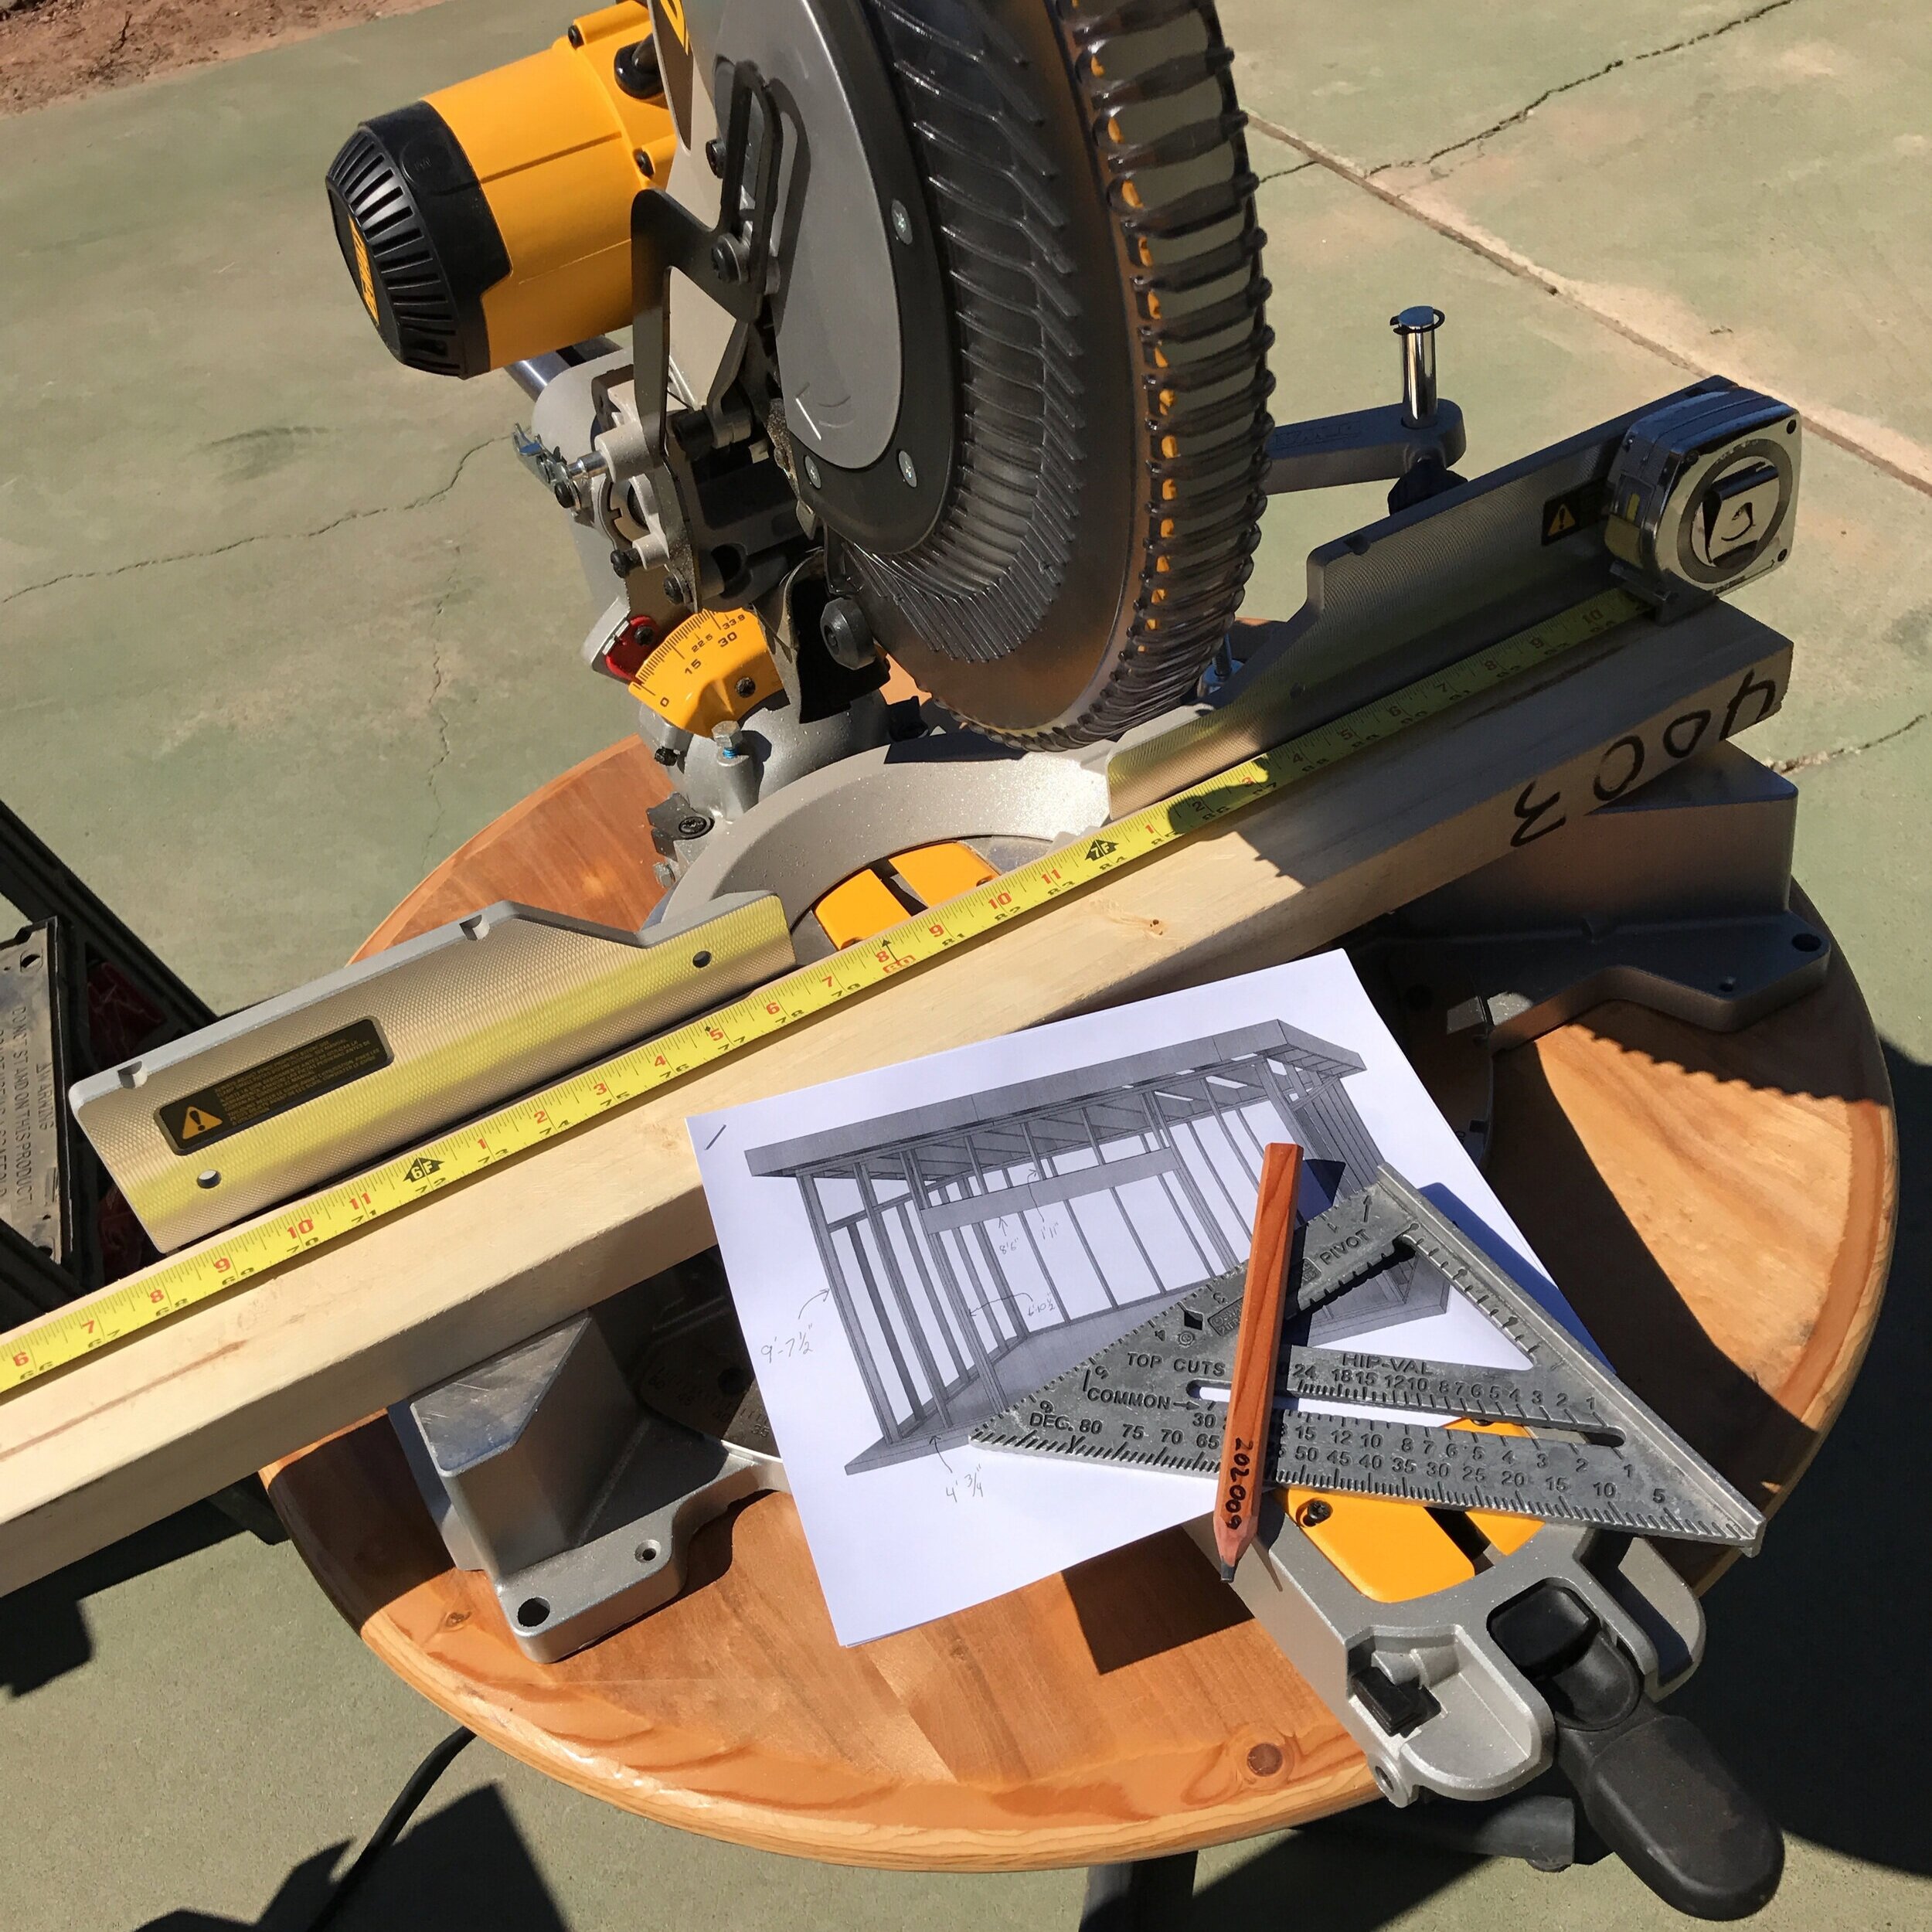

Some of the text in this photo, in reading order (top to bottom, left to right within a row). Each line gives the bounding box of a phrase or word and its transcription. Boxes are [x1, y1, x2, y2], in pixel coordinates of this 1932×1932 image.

[691, 633, 714, 654] 22.5
[717, 631, 738, 648] 30
[685, 659, 702, 675] 15
[659, 696, 670, 708] 0
[13, 1351, 29, 1367] 6
[82, 1319, 96, 1334] 7
[149, 1288, 165, 1304] 8
[215, 1257, 230, 1273] 9
[287, 1218, 315, 1239] 10
[349, 1192, 372, 1210] 11
[411, 1160, 434, 1181] 6F
[477, 1138, 487, 1150] 1
[534, 1110, 547, 1124] 2
[593, 1082, 607, 1097] 3
[654, 1054, 667, 1068] 4
[709, 1027, 724, 1042] 5
[766, 1001, 781, 1015] 6
[821, 975, 834, 988] 7
[875, 950, 889, 964] 8
[928, 923, 944, 938] 9
[988, 891, 1012, 910] 10
[1041, 868, 1063, 885] 11
[1090, 841, 1112, 859] 7F
[1145, 824, 1155, 835] 1
[1192, 800, 1206, 813] 2
[1292, 752, 1304, 764] 4
[1339, 728, 1353, 741] 5
[1389, 704, 1402, 718] 6
[1319, 1228, 1371, 1267] PIVOT
[1127, 1352, 1226, 1377] TOP CUTS
[1342, 1352, 1435, 1375] HIP-VAL
[1292, 1362, 1597, 1410] 24 18 15 12 10 8 7 6 5 4 3 2 1
[1087, 1387, 1172, 1410] COMMON
[1192, 1412, 1217, 1429] 30
[1295, 1424, 1318, 1441] 15
[1331, 1430, 1352, 1445] 12
[1360, 1434, 1383, 1448] 10
[1401, 1437, 1414, 1453] 8
[1423, 1440, 1436, 1454] 7
[1446, 1442, 1458, 1458] 6
[1472, 1446, 1485, 1461] 5
[1502, 1450, 1516, 1464] 4
[1536, 1453, 1549, 1468] 3
[1576, 1458, 1589, 1472] 2
[1624, 1463, 1634, 1478] 1
[1029, 1411, 1666, 1504] DEG. 80 75 70 65 50 45 40 35 30 25 20 15 10 5
